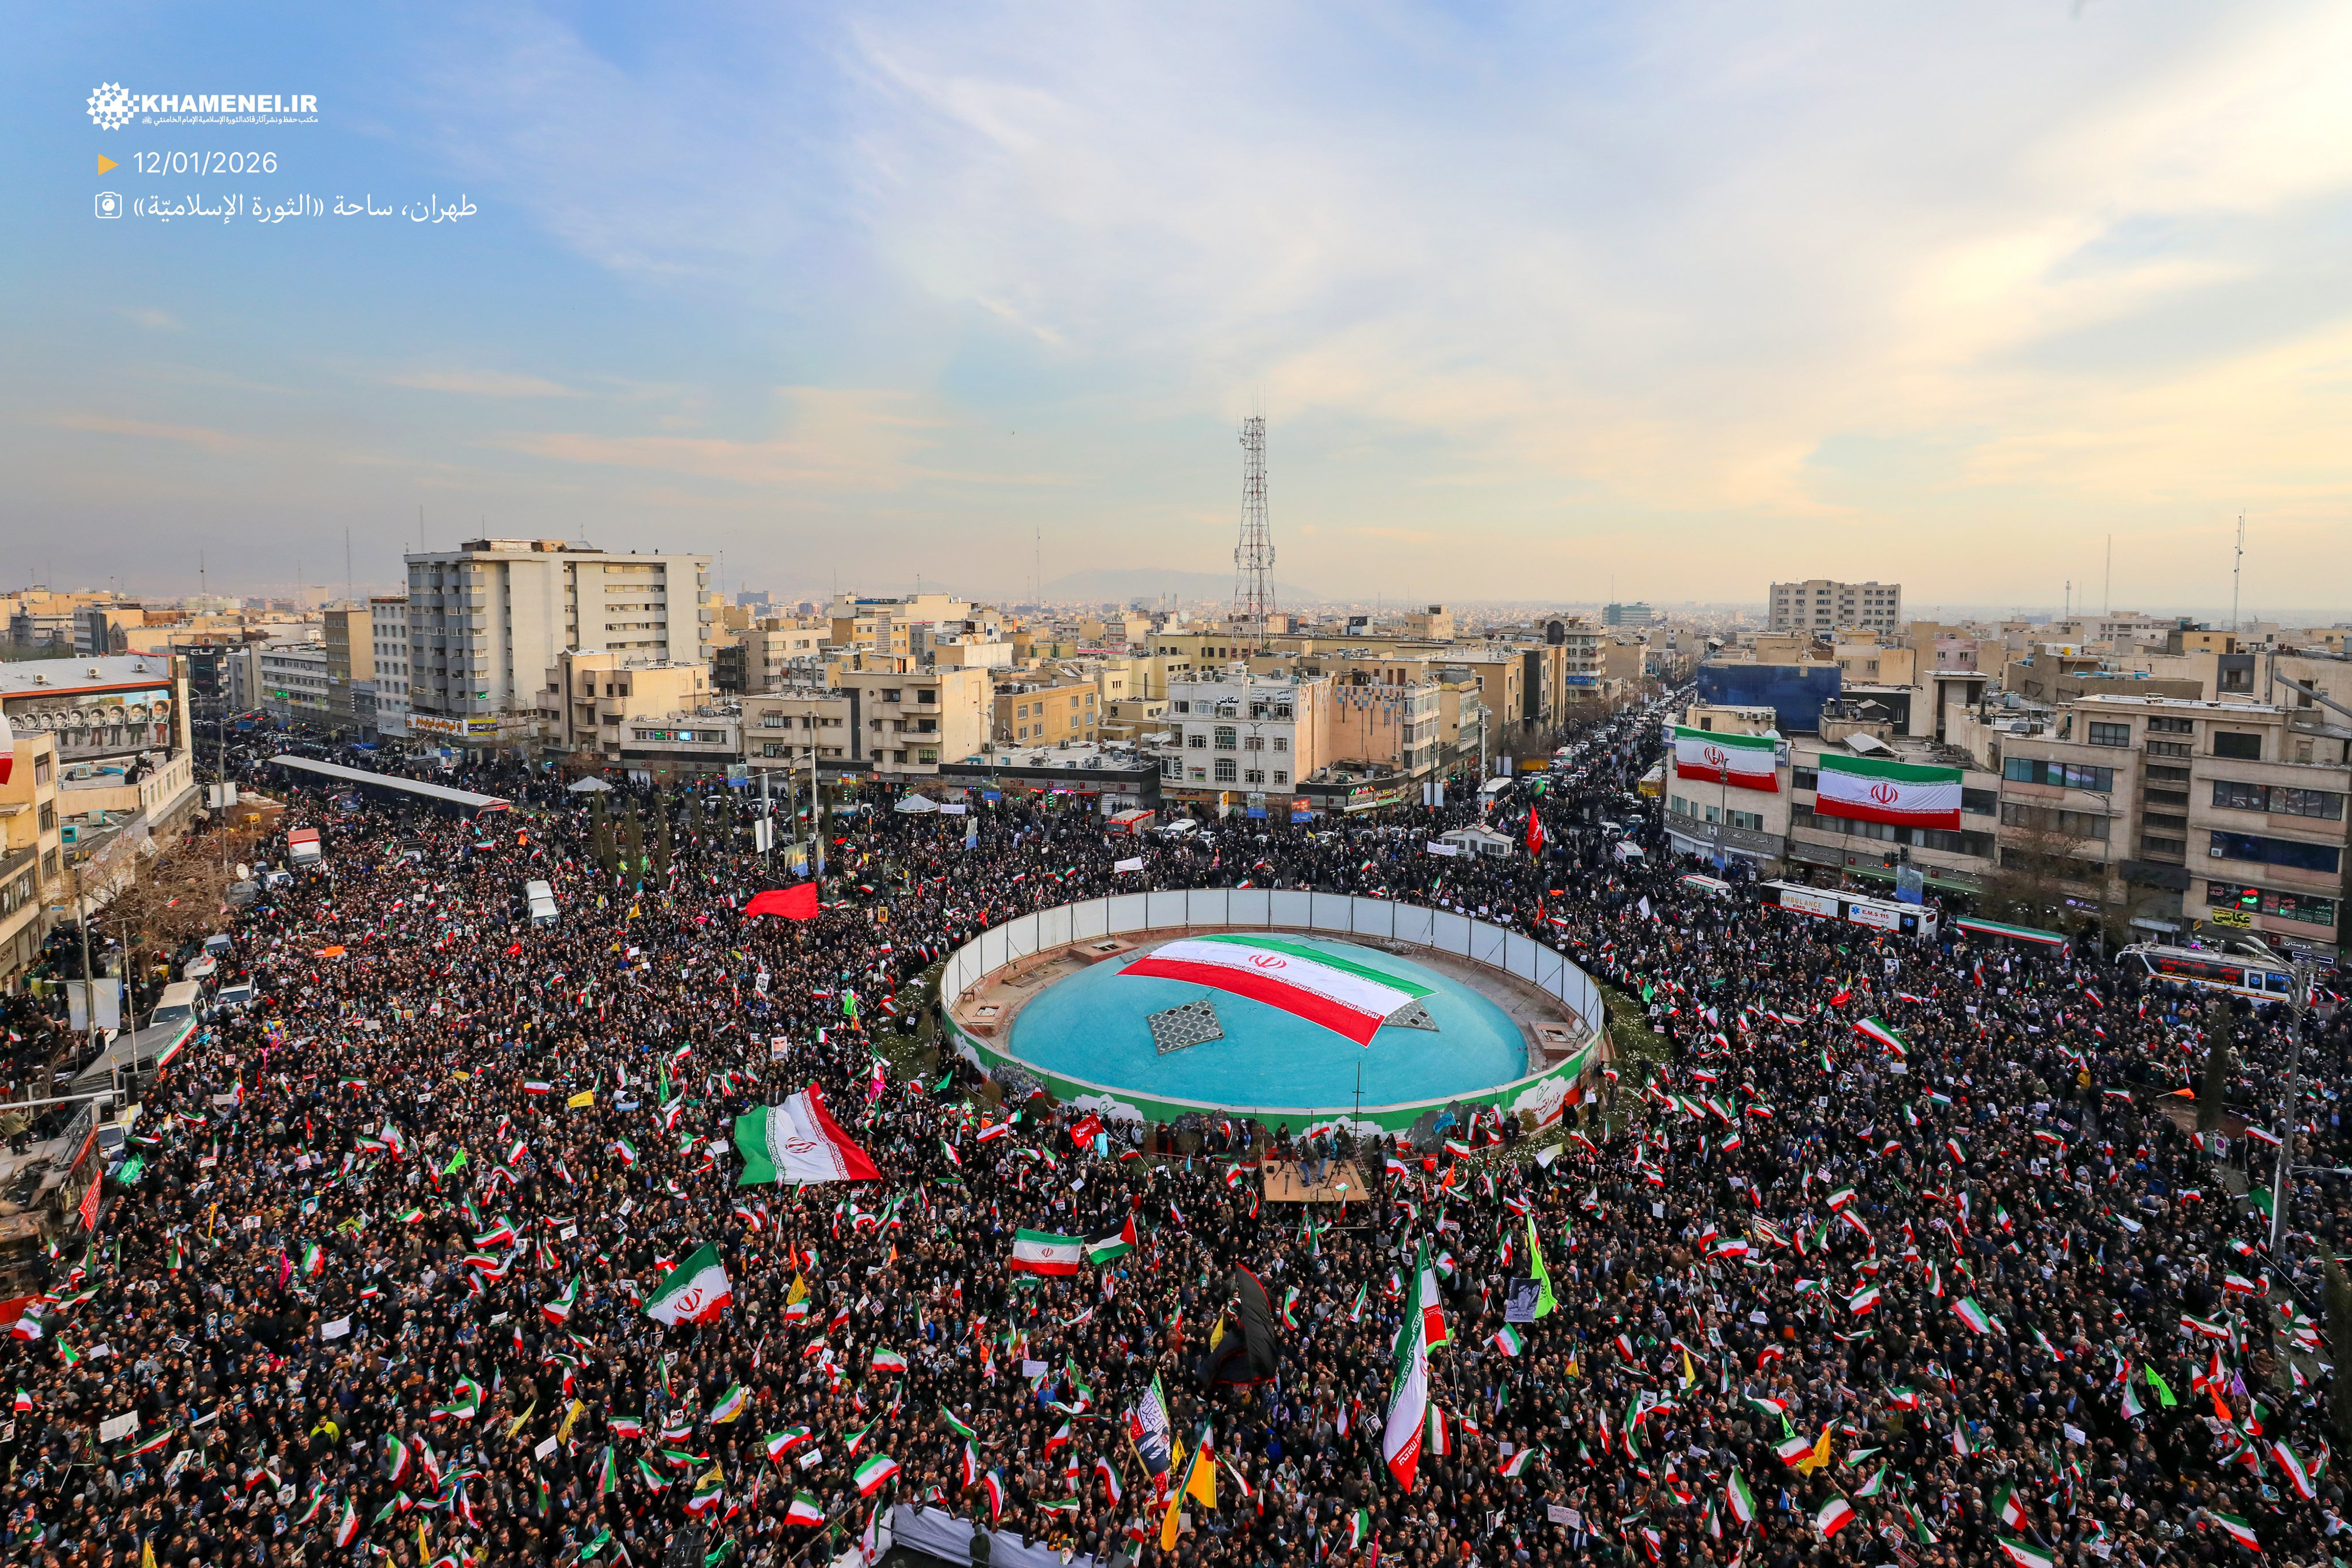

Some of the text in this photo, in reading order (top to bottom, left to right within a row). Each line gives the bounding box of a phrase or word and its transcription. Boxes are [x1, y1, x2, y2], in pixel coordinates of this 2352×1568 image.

[1758, 834, 1773, 847] بانک
[1780, 894, 1822, 909] AMBULANCE
[2213, 912, 2251, 924] عکاسی
[2284, 940, 2312, 950] دوستان
[1075, 1122, 1092, 1138] حسین
